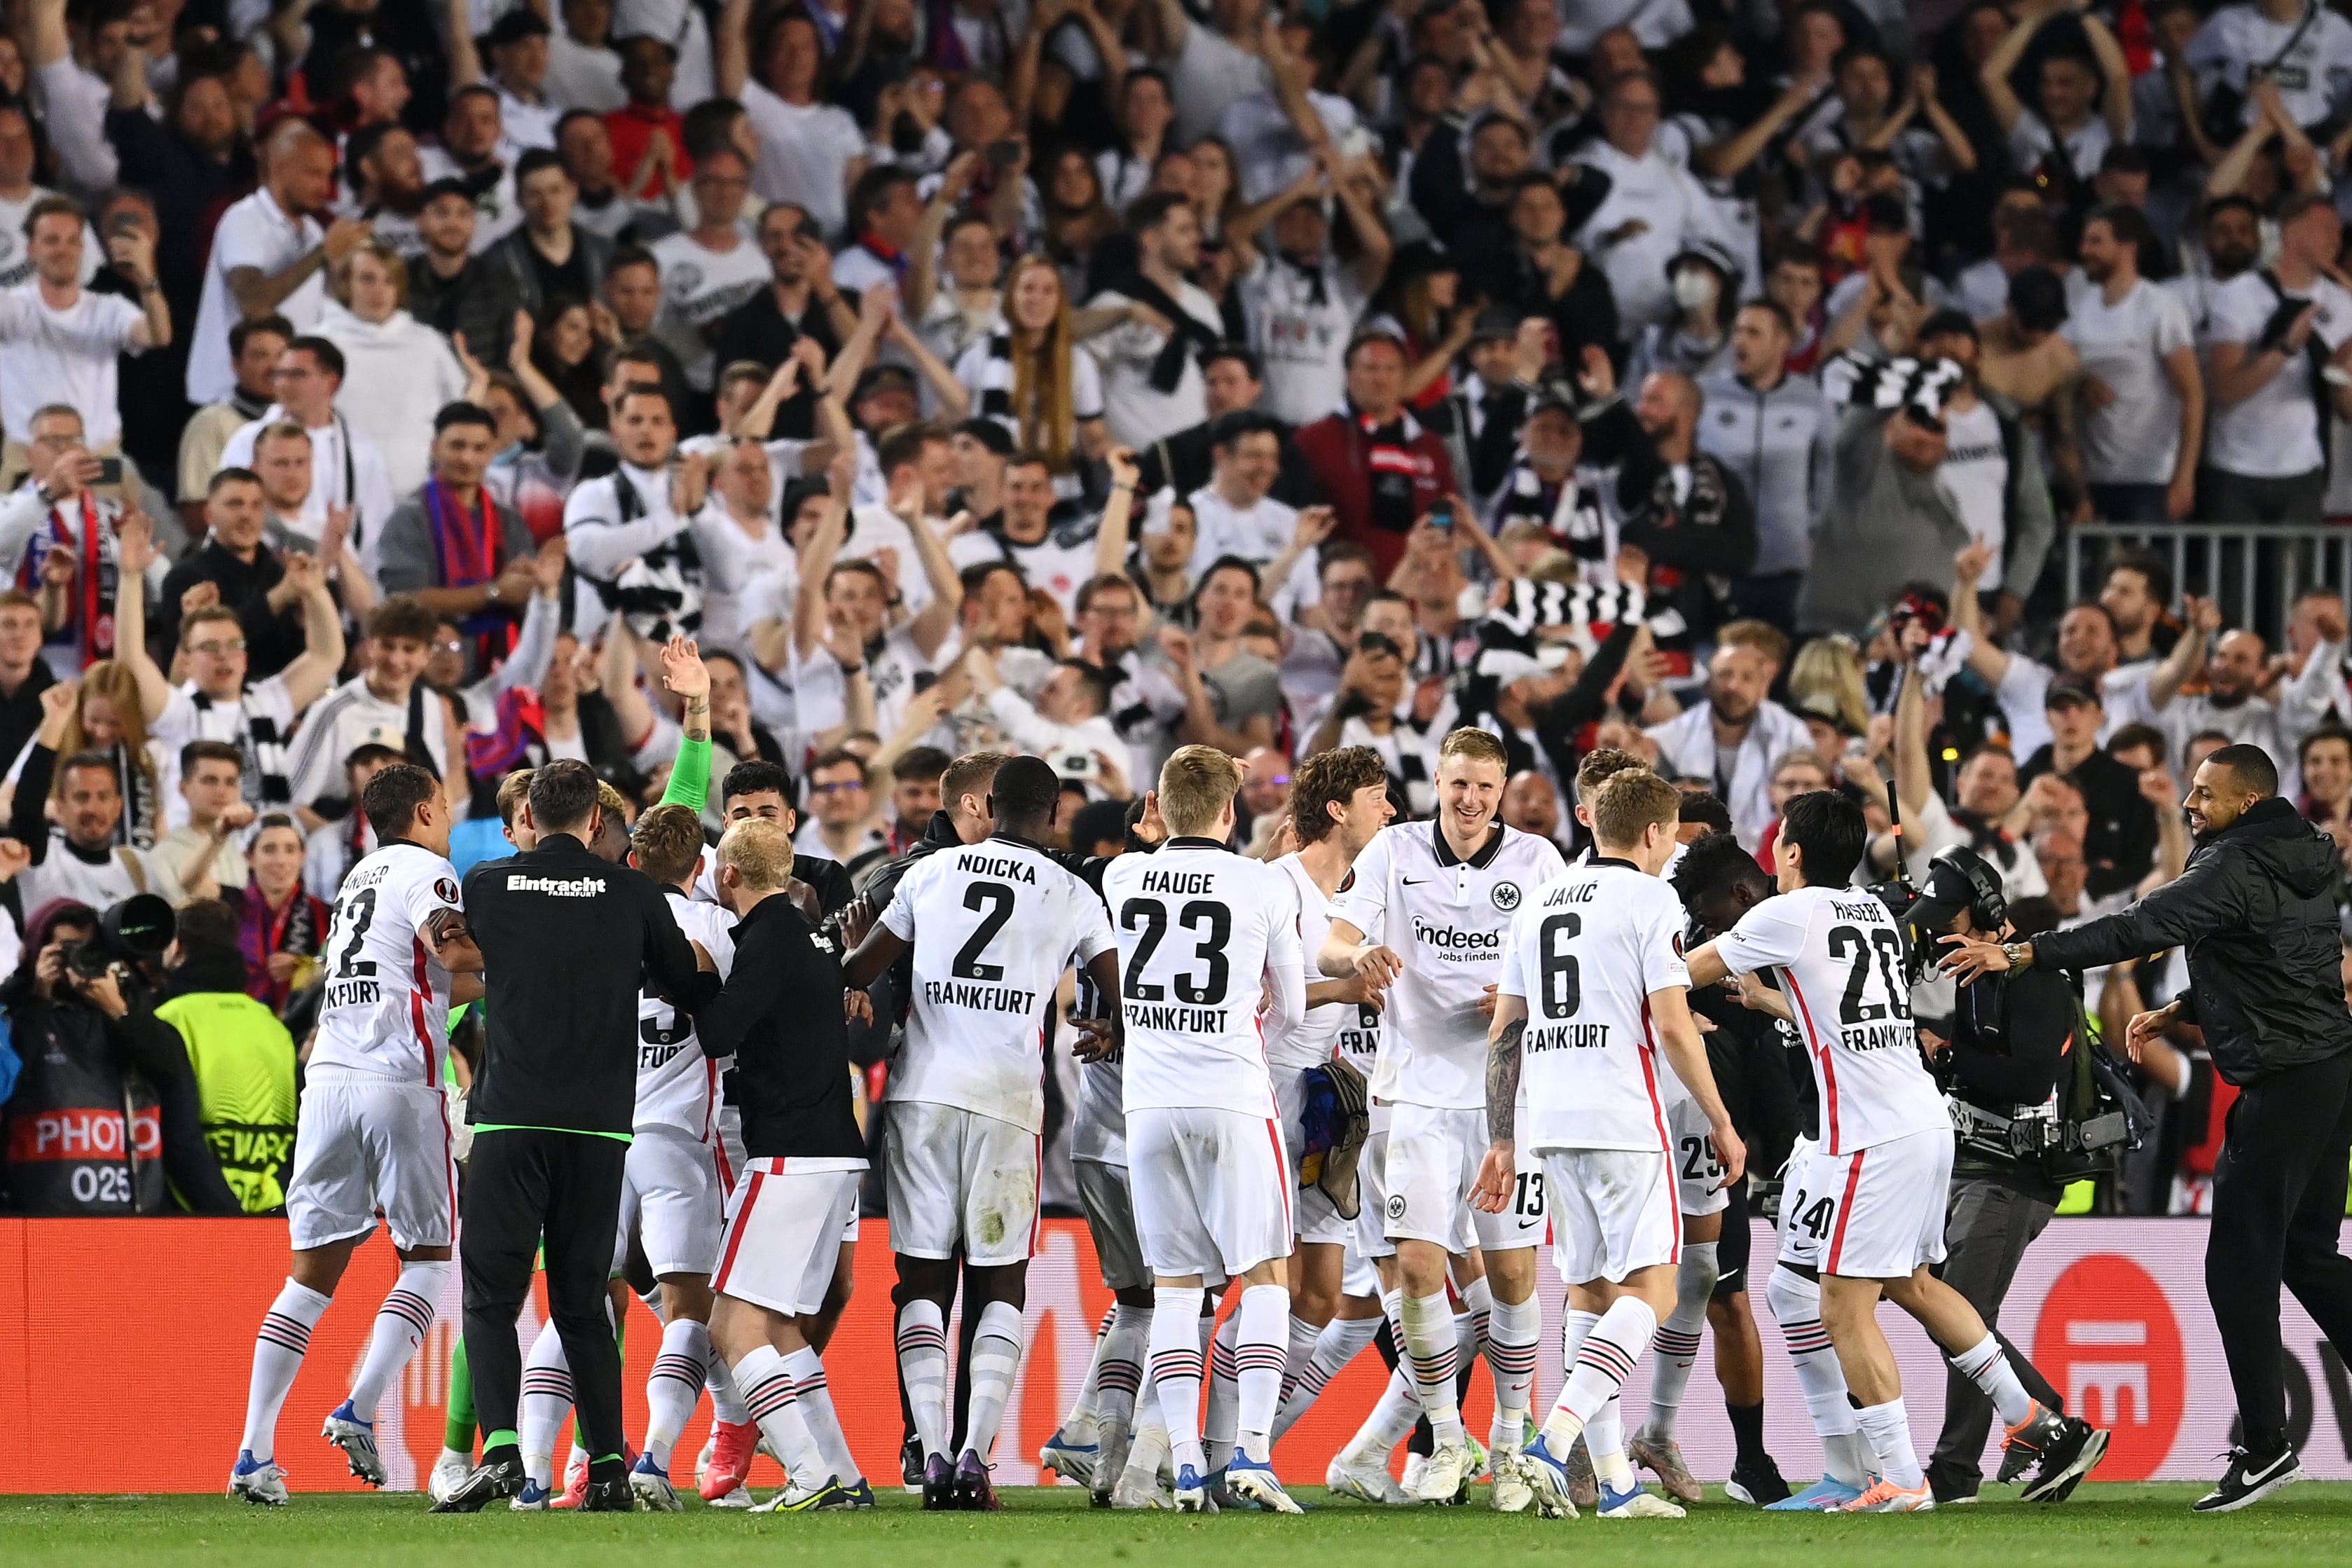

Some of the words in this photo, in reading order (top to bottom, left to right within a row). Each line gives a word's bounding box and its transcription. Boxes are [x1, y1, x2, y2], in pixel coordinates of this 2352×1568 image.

[507, 874, 607, 893] Eintracht
[958, 854, 1036, 886] NDICKA
[1142, 871, 1215, 894] HAUGE
[1543, 880, 1598, 907] JAKIĆ
[1830, 900, 1885, 923] HASEBE
[951, 881, 1016, 982] 2
[1412, 916, 1499, 949] indeed
[1120, 898, 1232, 1005] 23
[1437, 951, 1463, 963] Jobs
[1464, 951, 1500, 962] finden
[1540, 912, 1581, 1019] 6
[1827, 925, 1913, 1025] 20
[926, 981, 1036, 1015] FRANKFURT
[36, 1115, 161, 1154] PHOTO
[70, 1165, 132, 1204] 025
[1515, 1171, 1543, 1216] 13
